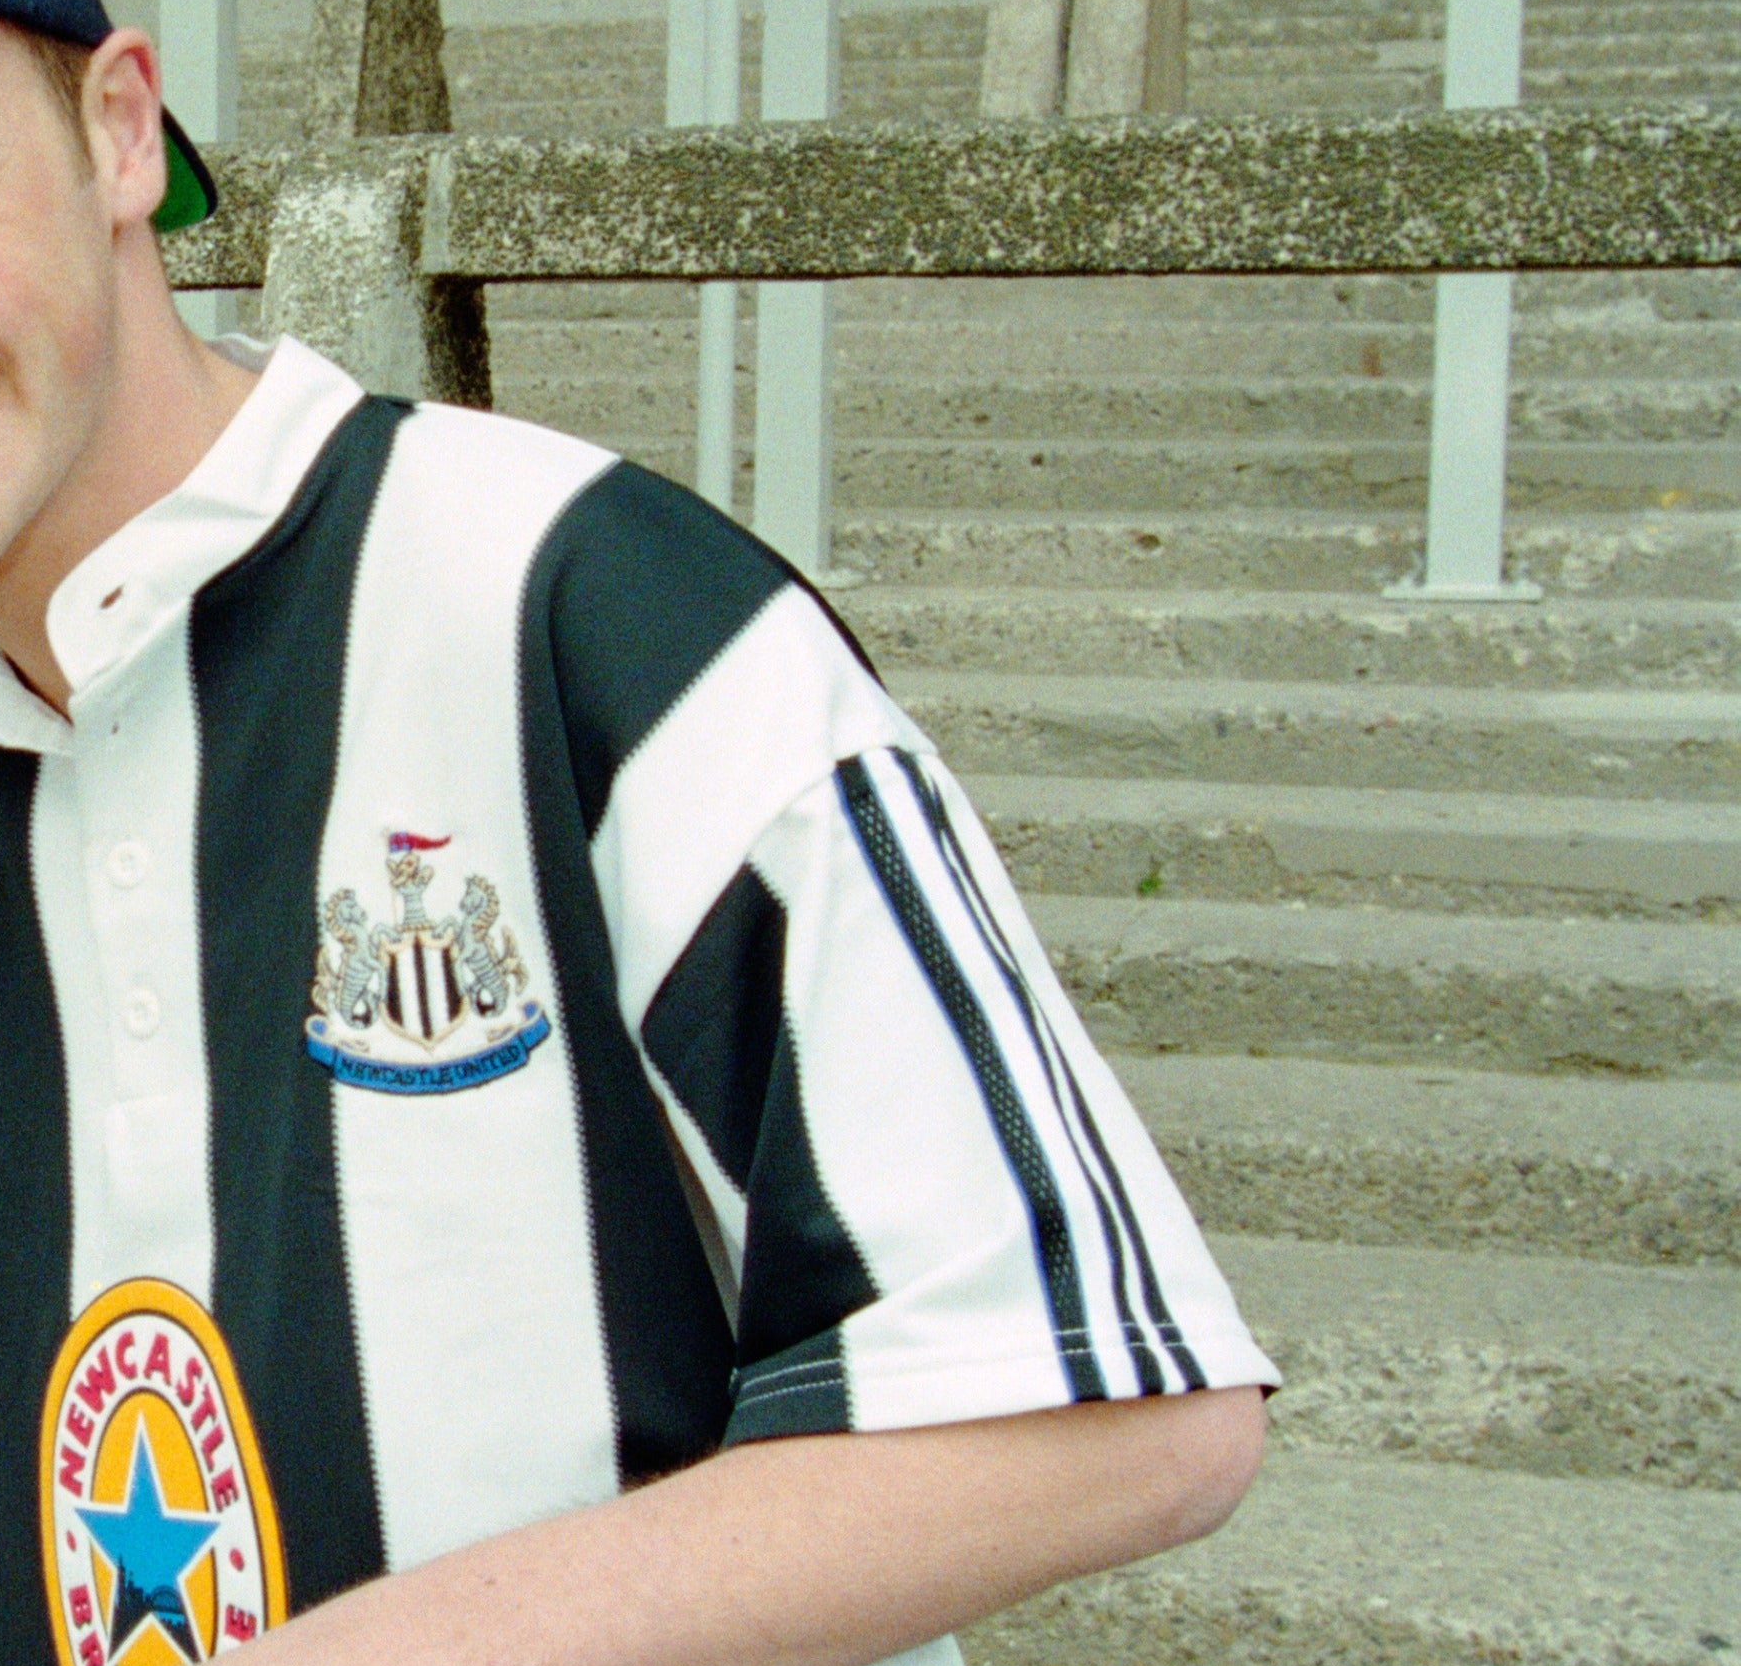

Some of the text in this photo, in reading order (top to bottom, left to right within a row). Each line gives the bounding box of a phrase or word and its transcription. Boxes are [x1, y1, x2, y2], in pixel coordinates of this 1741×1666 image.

[340, 1043, 522, 1086] NEWCASTLE UNITED
[58, 1331, 239, 1513] NEWCASTLE
